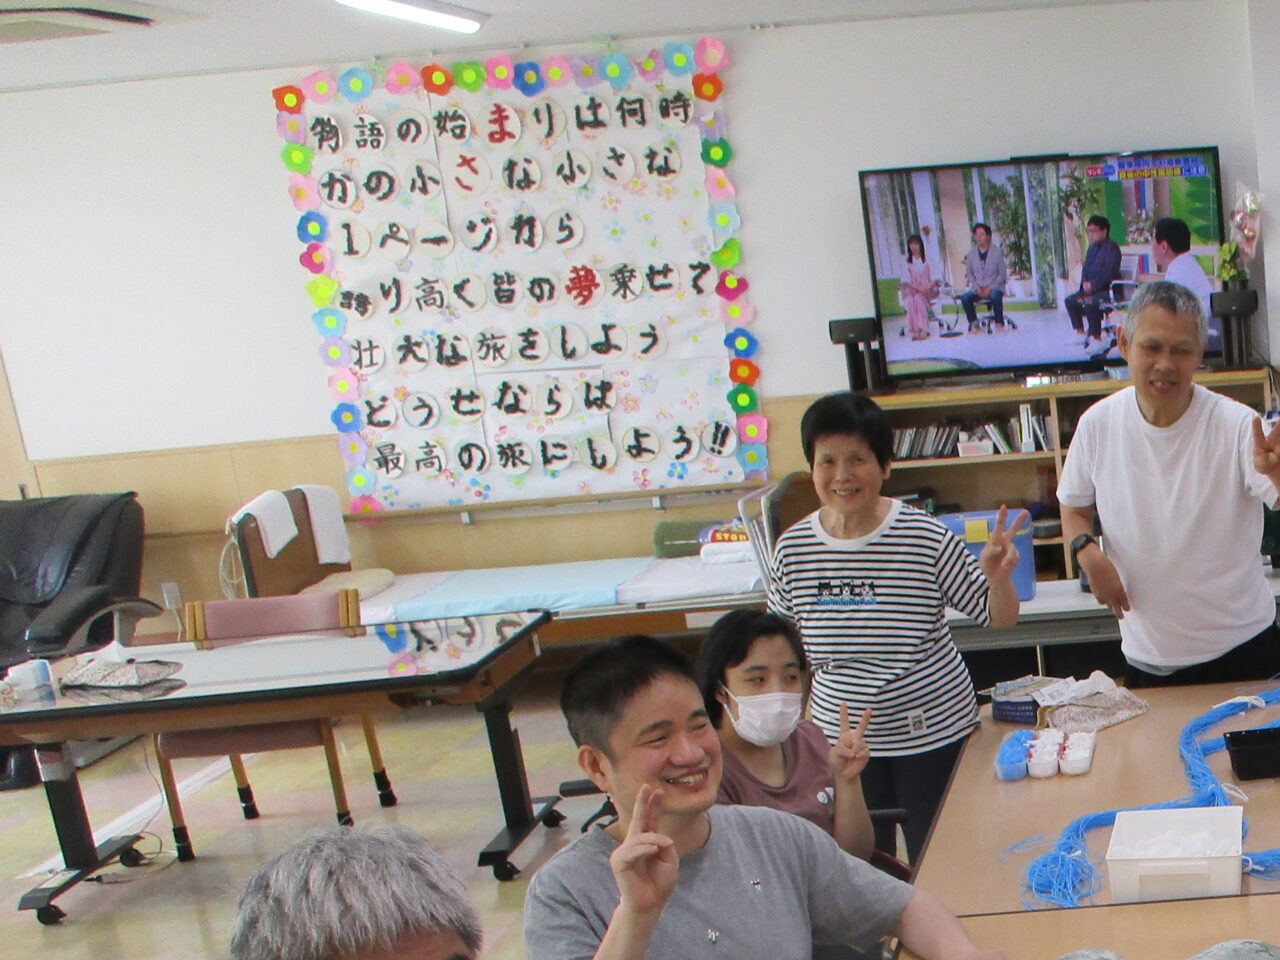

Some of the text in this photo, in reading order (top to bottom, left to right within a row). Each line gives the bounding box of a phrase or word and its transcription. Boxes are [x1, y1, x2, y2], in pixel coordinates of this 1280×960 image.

[310, 91, 692, 154] 物語の始まりは何時
[321, 146, 677, 204] かの小さな小さな
[351, 328, 660, 370] 壮大な旅をしよう
